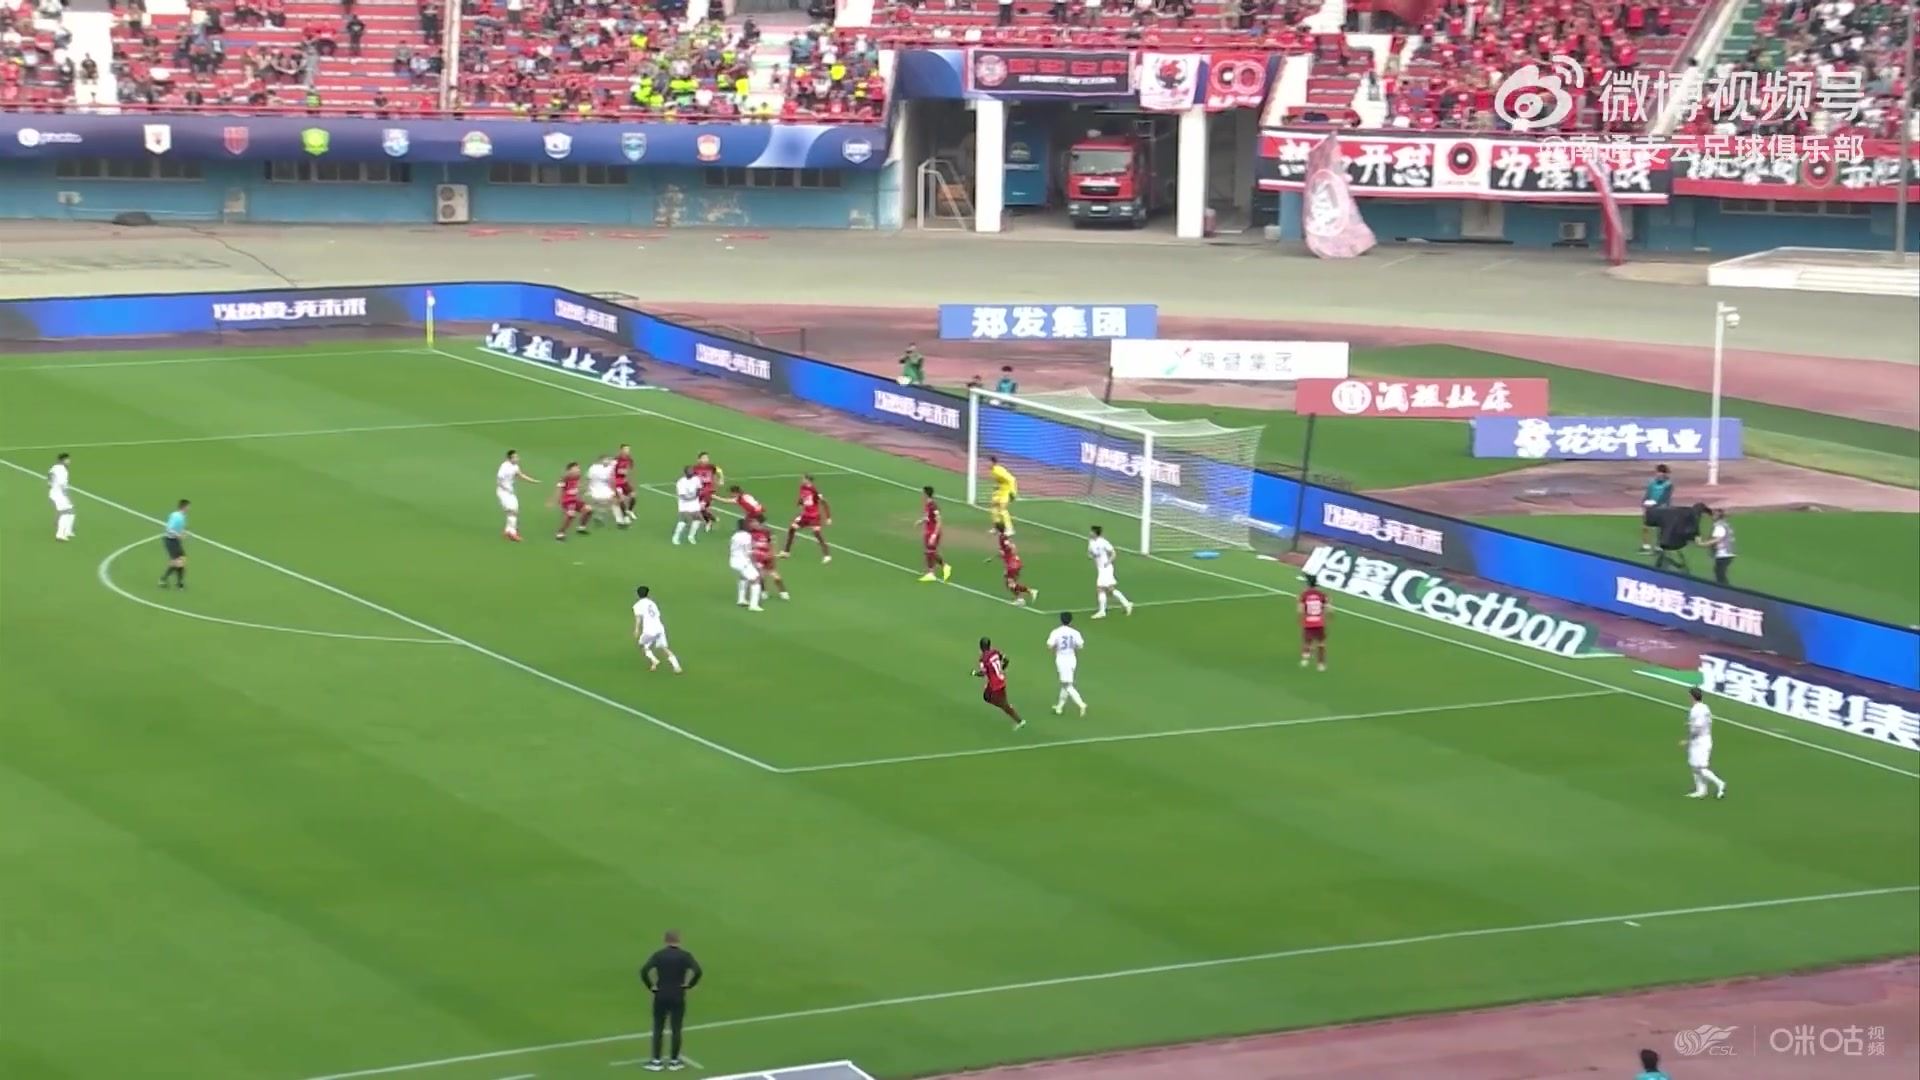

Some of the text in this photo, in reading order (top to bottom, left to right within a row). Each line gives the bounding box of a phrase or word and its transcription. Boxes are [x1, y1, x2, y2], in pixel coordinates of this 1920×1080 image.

[973, 306, 1127, 338] 郑发集团
[1556, 422, 1703, 457] 花花牛乳业
[1390, 569, 1588, 656] C'estbon
